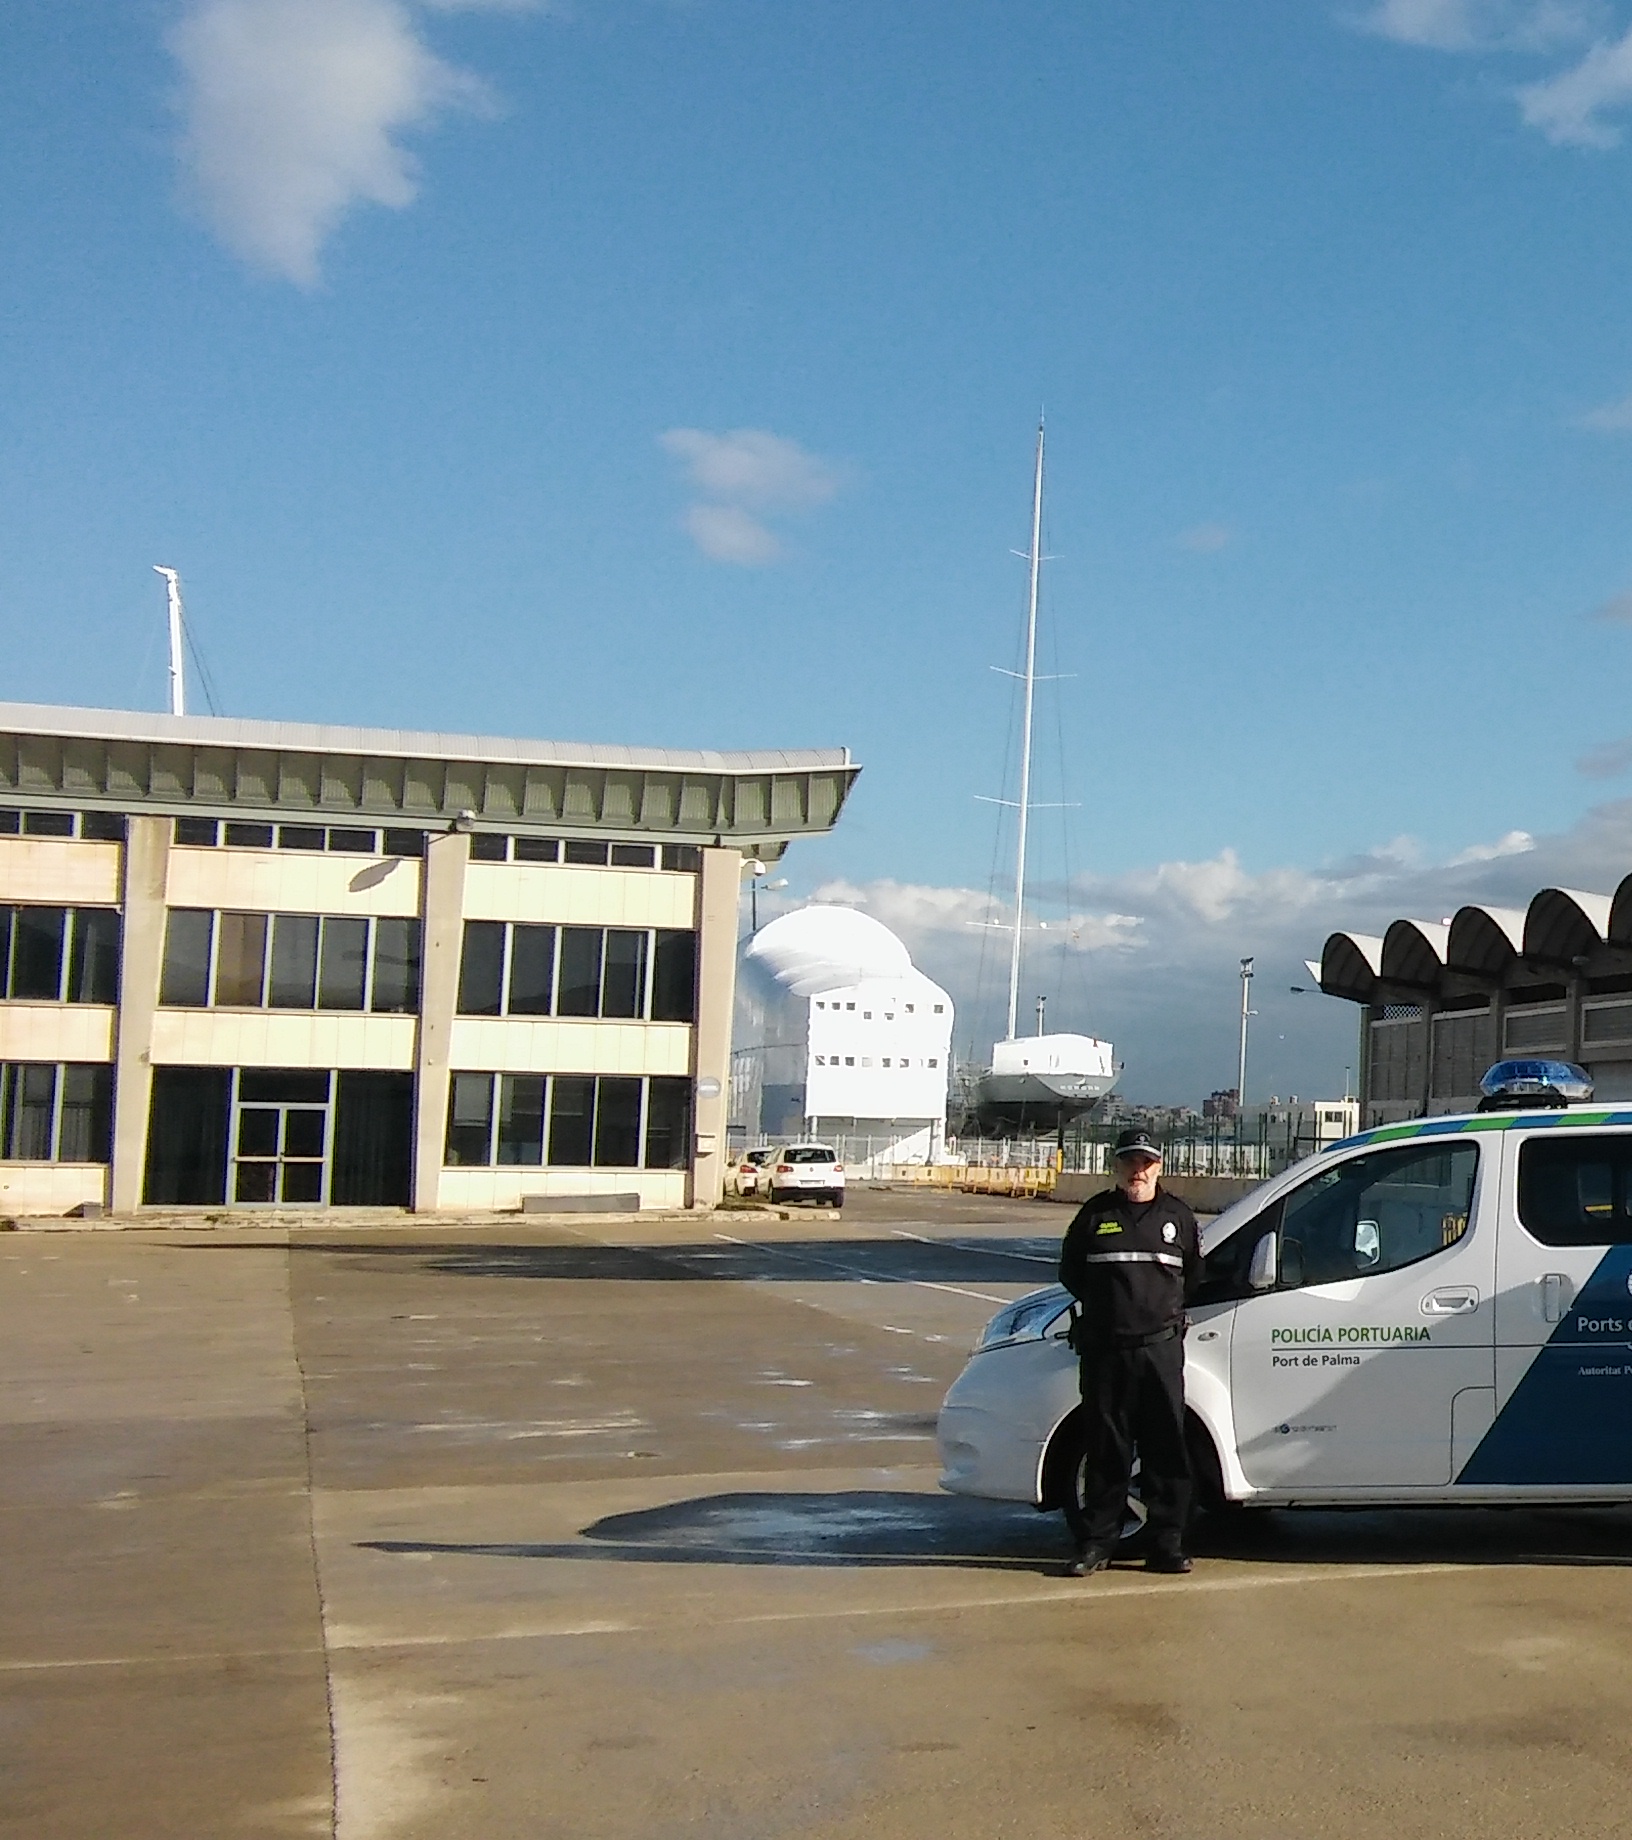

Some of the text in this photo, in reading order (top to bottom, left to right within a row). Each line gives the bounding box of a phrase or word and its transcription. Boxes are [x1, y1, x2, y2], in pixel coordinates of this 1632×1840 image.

[1577, 1316, 1623, 1332] Ports
[1271, 1324, 1431, 1343] POLICÍA PORTUARIA
[1272, 1354, 1361, 1367] Port de Palma
[1578, 1365, 1621, 1375] Autoritat
